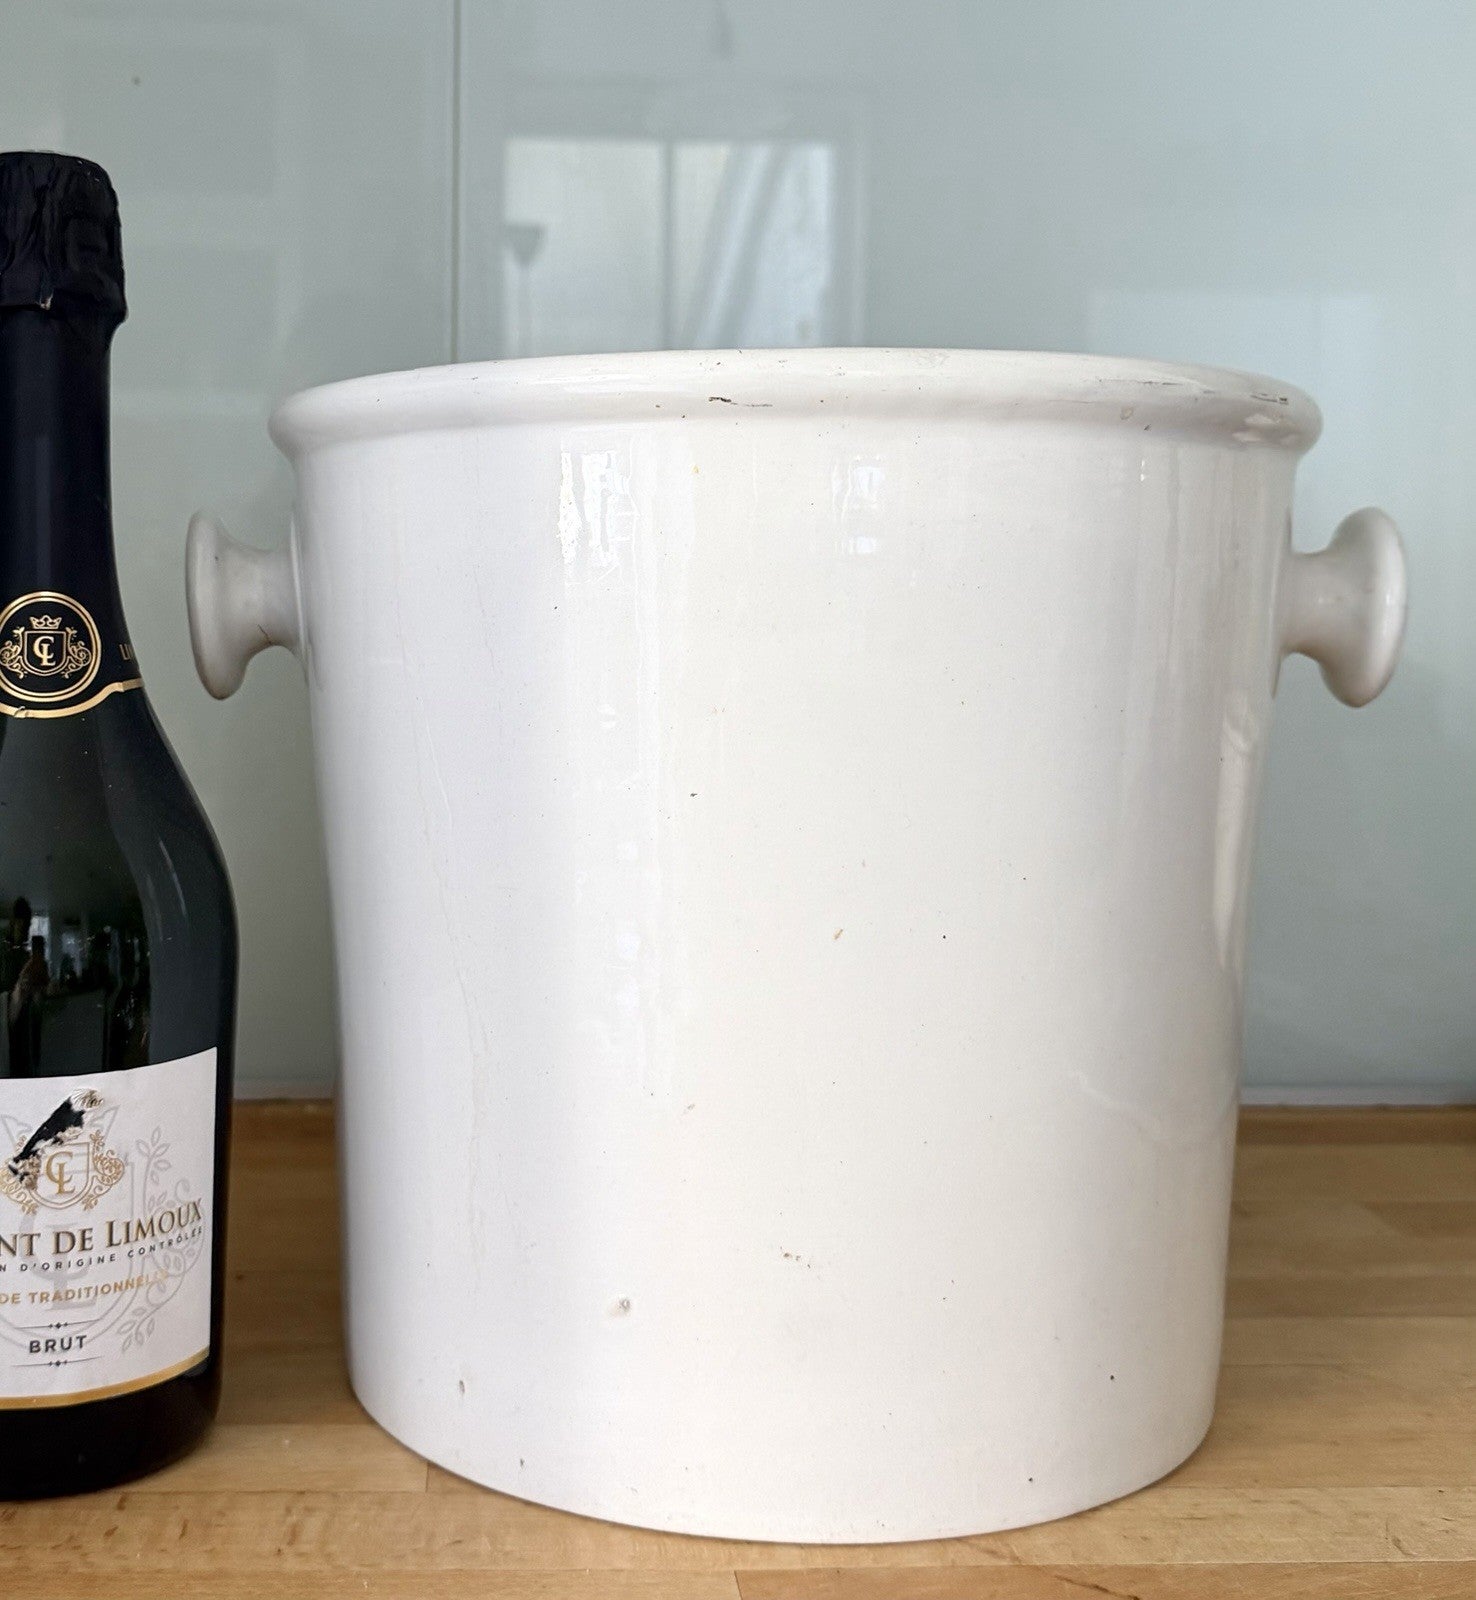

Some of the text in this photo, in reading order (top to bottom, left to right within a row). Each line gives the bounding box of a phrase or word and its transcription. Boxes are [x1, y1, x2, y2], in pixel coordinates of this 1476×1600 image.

[52, 1228, 94, 1255] DE
[105, 1198, 202, 1248] LIMOUX
[20, 1253, 116, 1272] D'ORIGINE
[28, 1268, 168, 1304] TRADITIONNEL
[29, 1335, 87, 1354] BRUT
